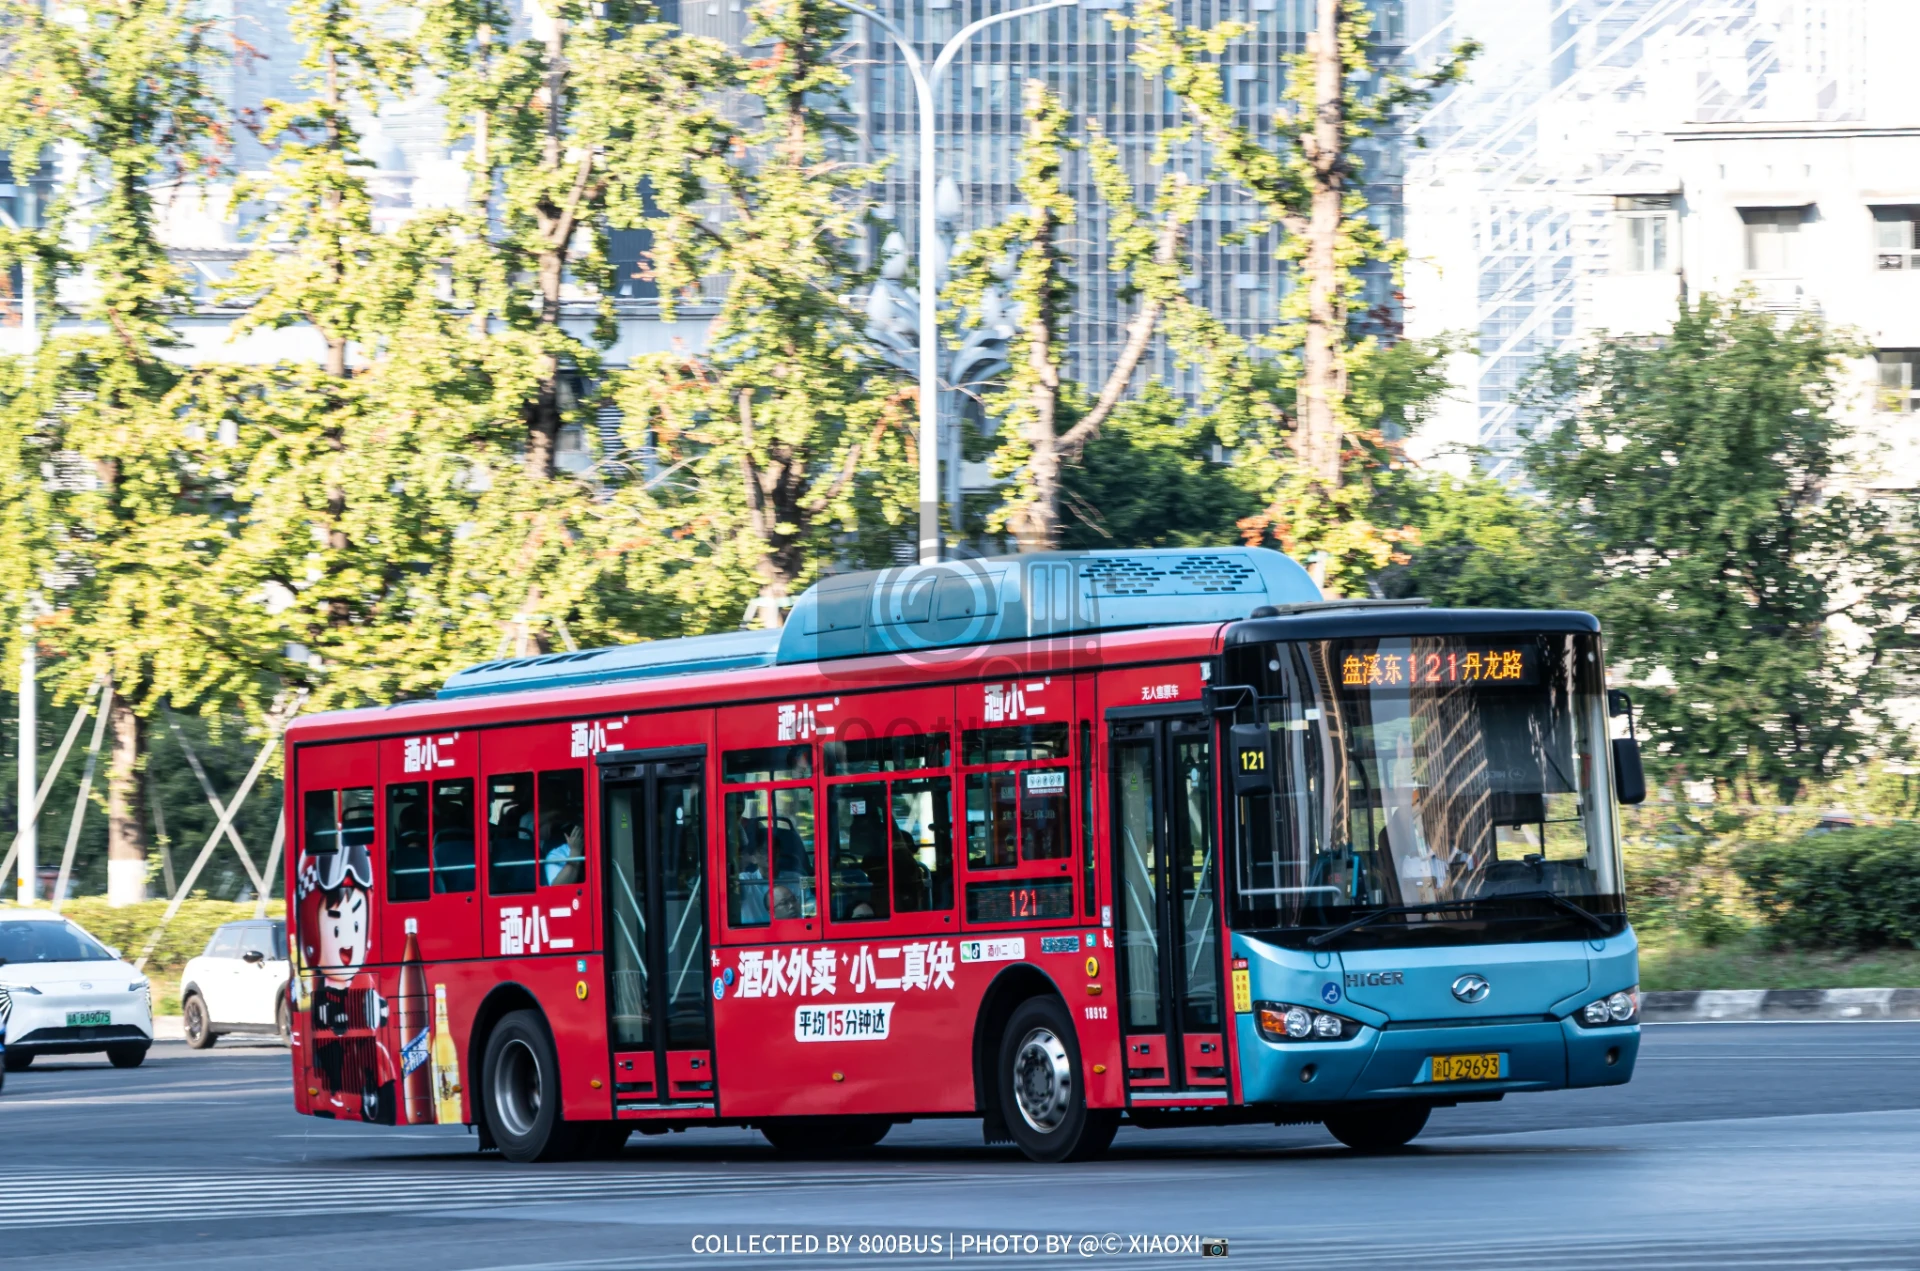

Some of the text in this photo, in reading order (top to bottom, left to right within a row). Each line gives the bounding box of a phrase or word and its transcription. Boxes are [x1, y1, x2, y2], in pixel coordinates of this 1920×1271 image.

[1343, 650, 1523, 686] 盘溪东 121 丹龙路
[984, 683, 1046, 722] 酒小二
[1141, 684, 1179, 701] 无人售票车
[571, 722, 624, 758] 酒小二
[778, 703, 835, 741] 酒小二
[404, 737, 455, 773] 酒小二
[1241, 751, 1265, 770] 121
[1009, 890, 1037, 917] 121
[500, 906, 574, 955] 酒小二
[733, 940, 956, 998] 酒水外卖 小二真快
[1346, 971, 1404, 988] HIGER
[799, 1008, 886, 1037] 平均15分钟达
[1085, 1006, 1108, 1020] 18912
